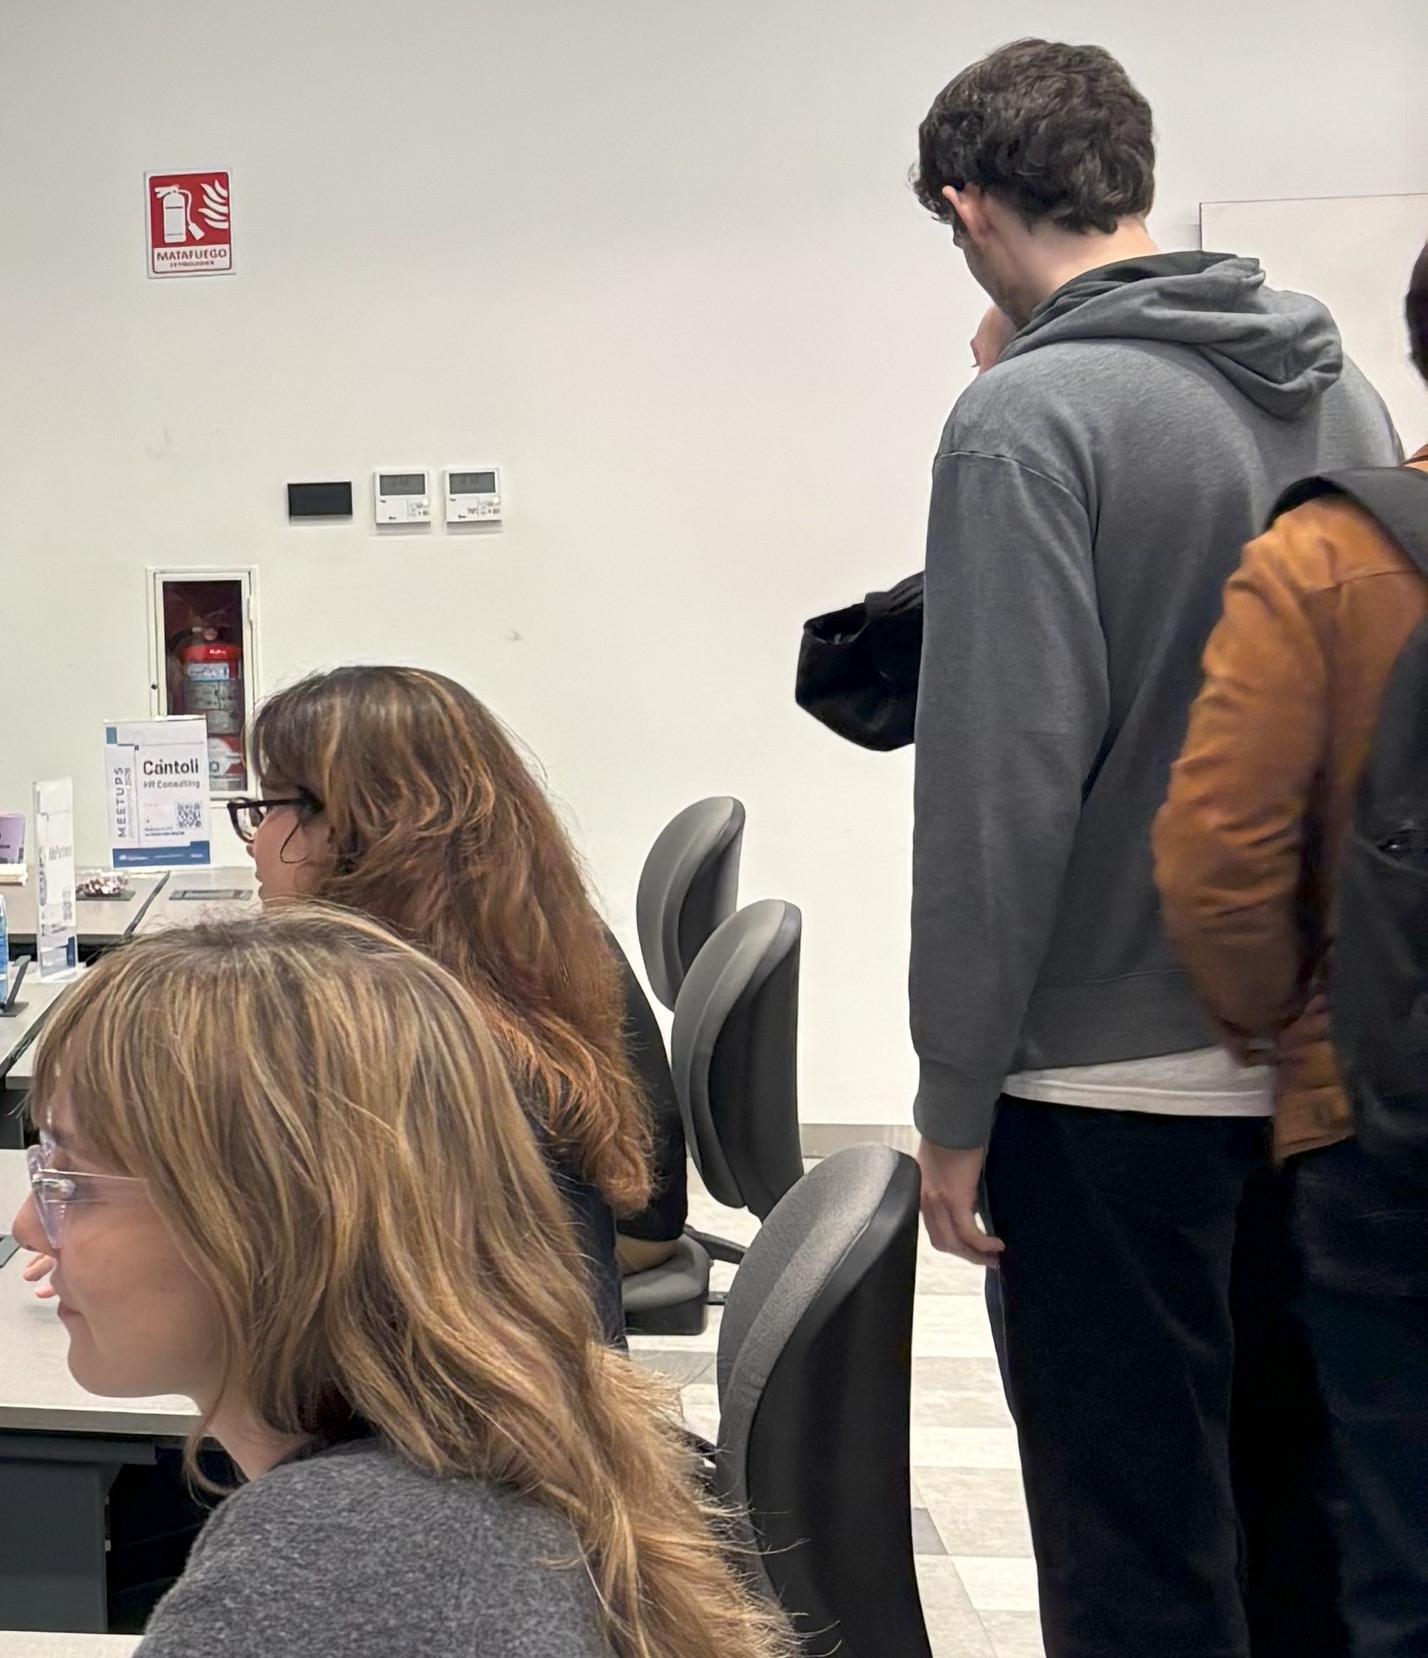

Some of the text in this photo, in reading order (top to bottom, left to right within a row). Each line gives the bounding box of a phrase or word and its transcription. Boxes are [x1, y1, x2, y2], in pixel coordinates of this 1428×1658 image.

[156, 248, 227, 261] MATAFUEGO
[157, 780, 200, 790] Consulting
[113, 767, 127, 838] MEETUPS
